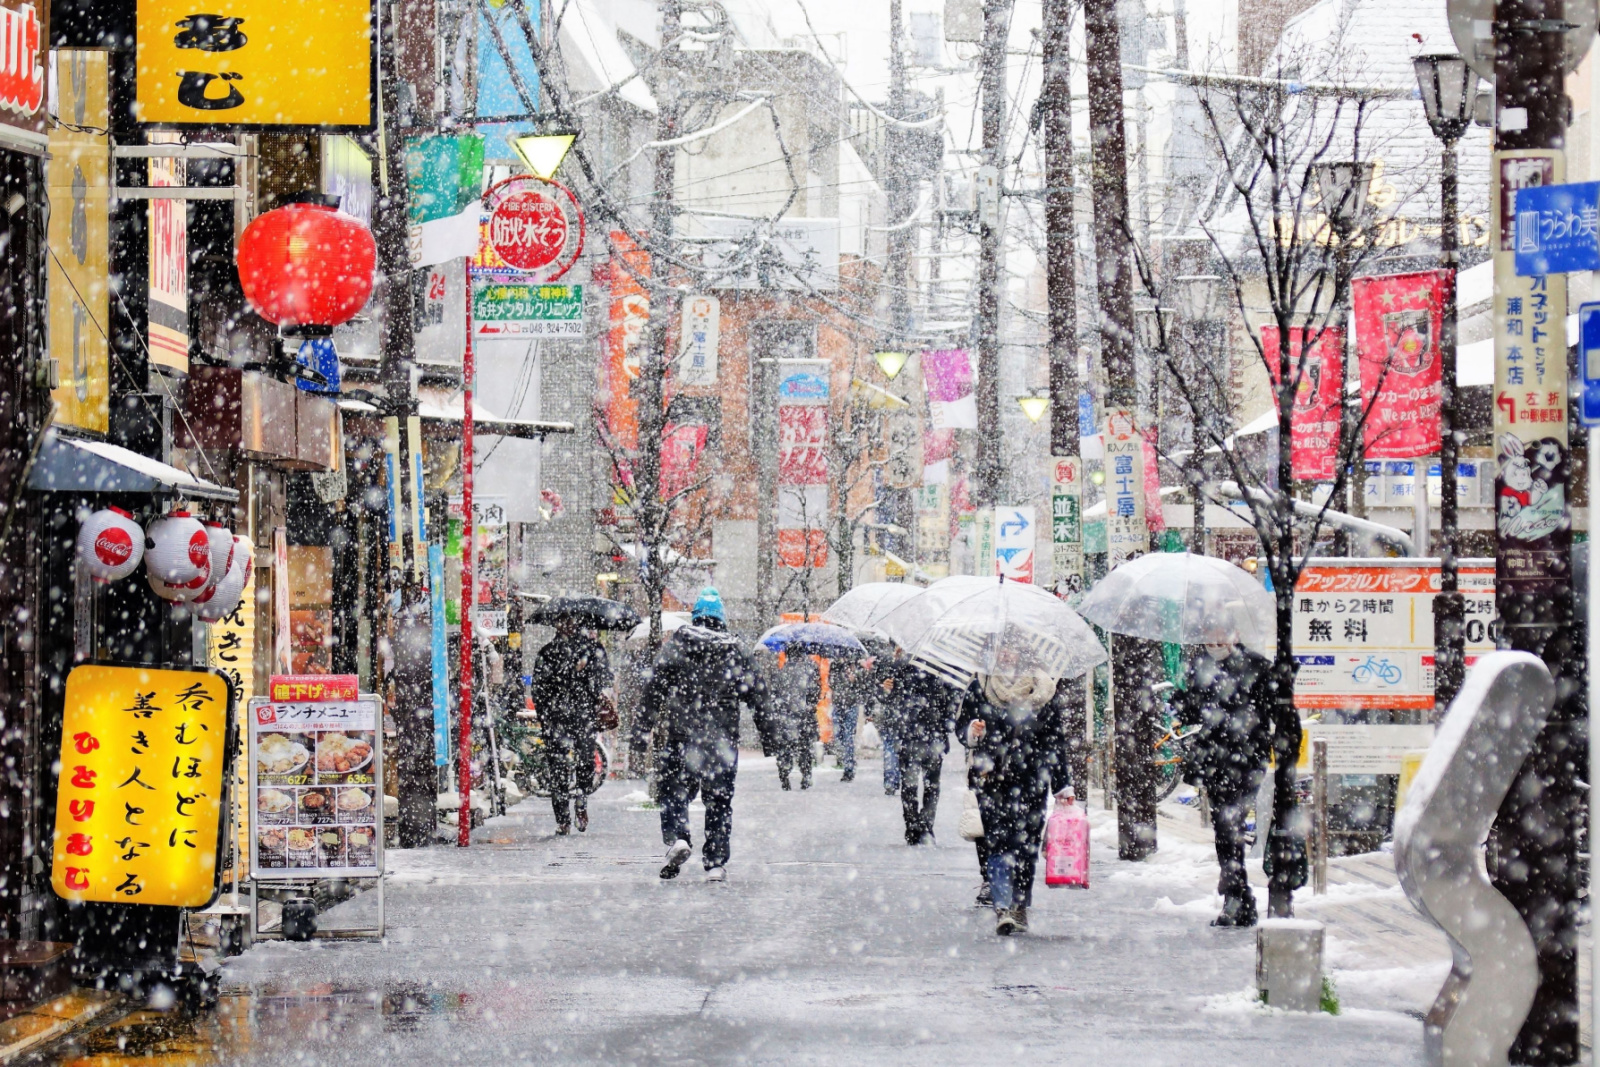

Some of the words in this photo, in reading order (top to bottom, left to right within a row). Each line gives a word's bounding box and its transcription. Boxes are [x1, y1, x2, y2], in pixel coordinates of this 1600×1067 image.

[503, 202, 519, 212] FIRE
[522, 202, 554, 212] CISTERN
[493, 216, 565, 247] 防火水そう
[478, 301, 581, 317] 坂井メンタルクリニック
[501, 323, 520, 334] 入口
[1381, 408, 1398, 422] We
[1400, 410, 1418, 423] are
[1114, 455, 1135, 517] 富士屋
[1054, 498, 1073, 541] 並木
[95, 537, 132, 557] Coca-Cola
[1303, 572, 1422, 590] アップルパーク
[1308, 618, 1368, 642] 無料
[276, 705, 357, 719] ランチメニュー
[169, 682, 215, 848] 呑むほどに
[114, 691, 163, 896] 善き人となる
[64, 731, 100, 891] ひとりあじ
